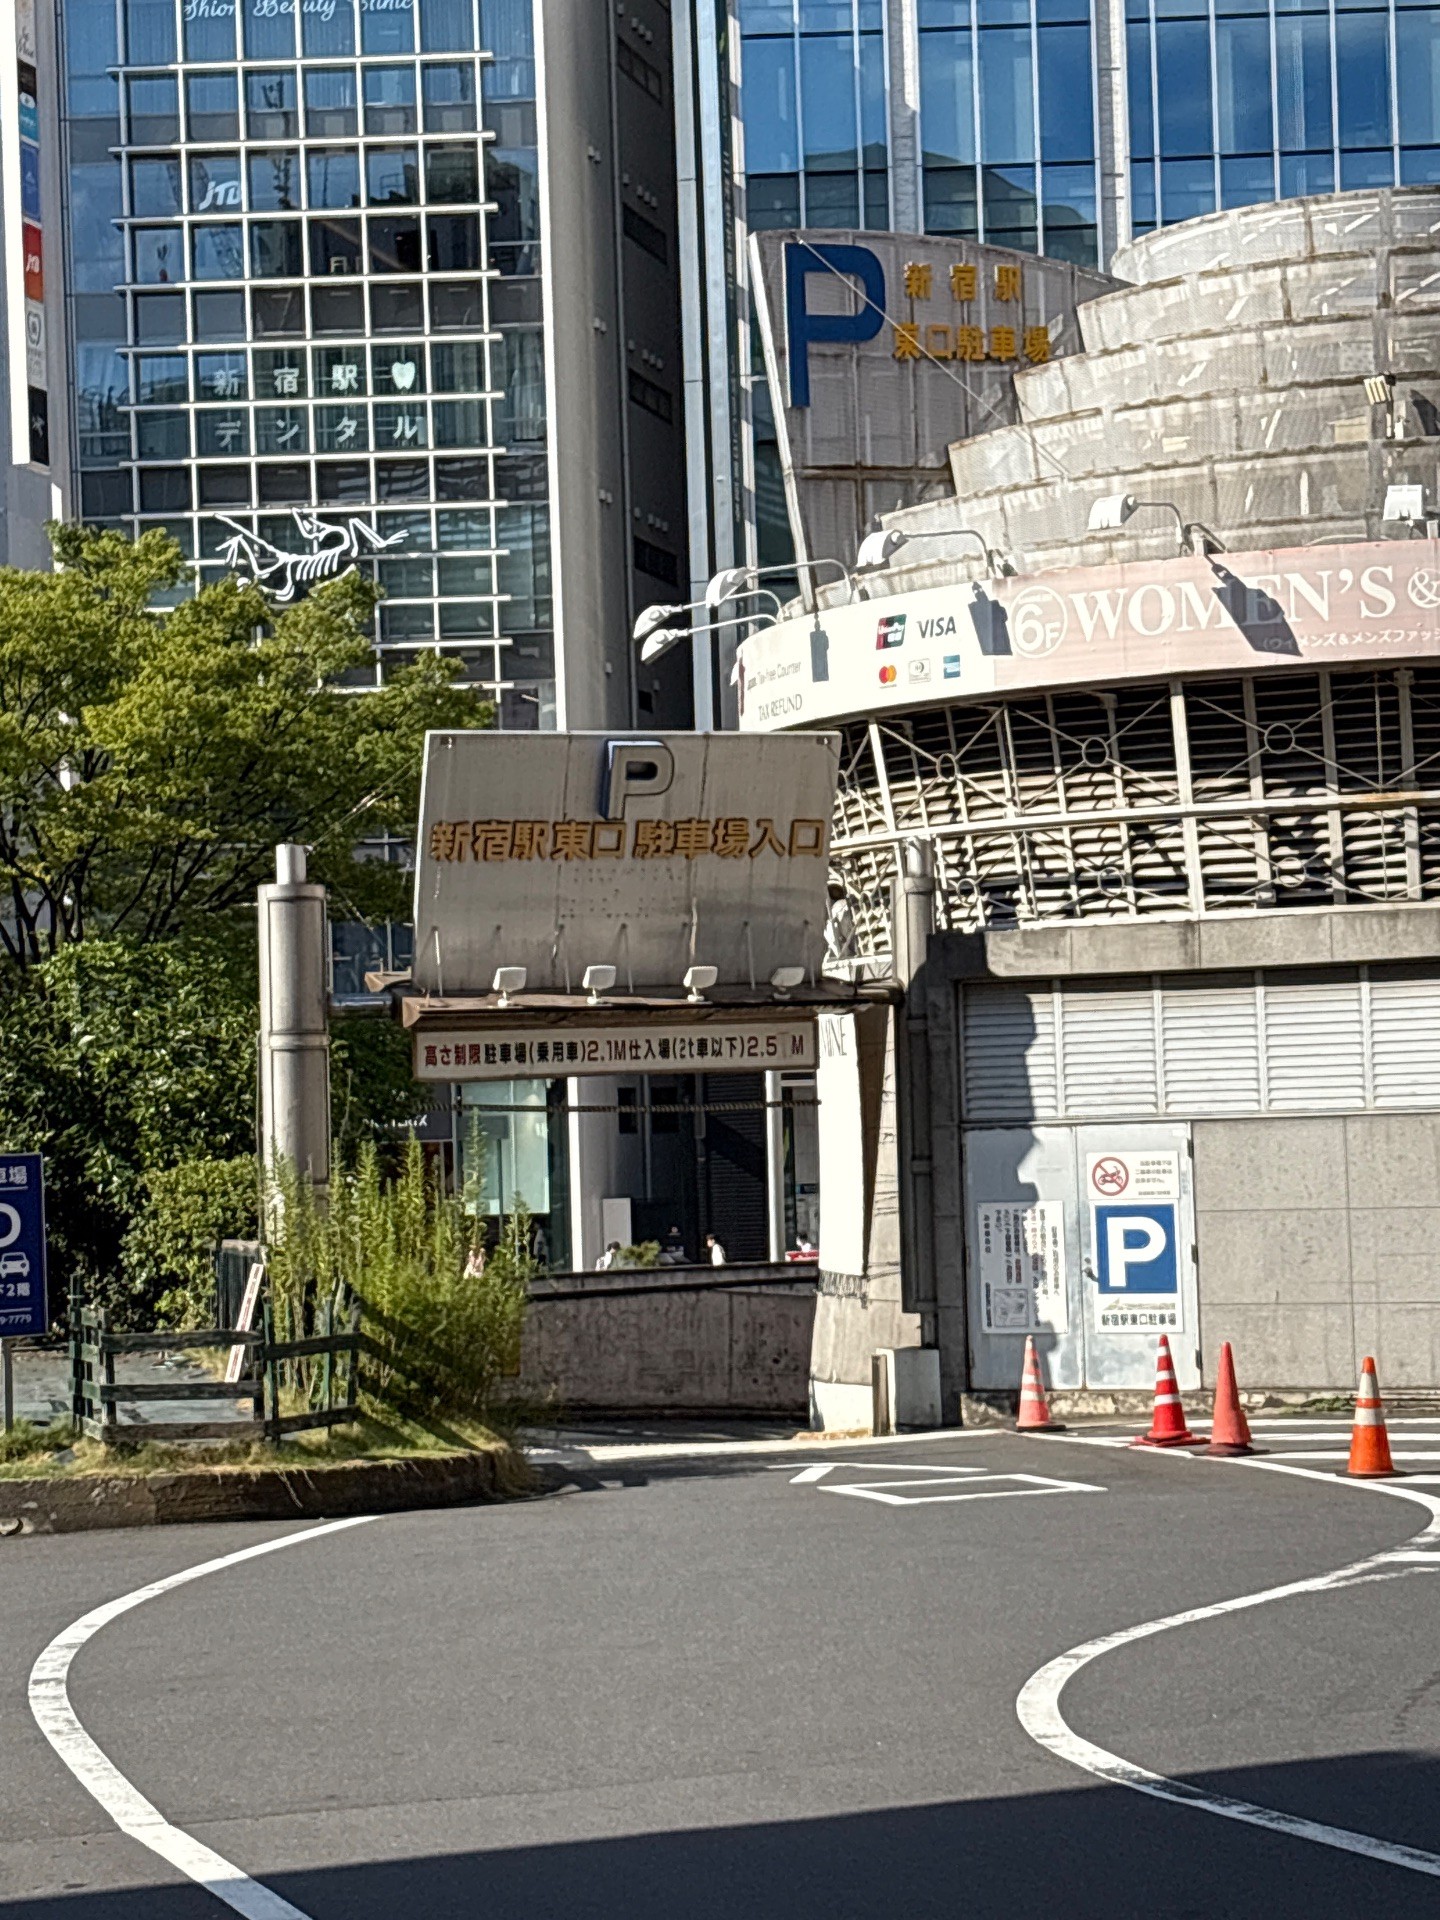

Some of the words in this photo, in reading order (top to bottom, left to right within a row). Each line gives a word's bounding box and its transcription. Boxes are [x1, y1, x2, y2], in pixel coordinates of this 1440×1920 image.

[904, 261, 1022, 301] 新宿駅
[781, 242, 886, 408] P
[893, 321, 1051, 362] 東口駐車場
[214, 364, 359, 396] 新宿駅
[215, 415, 419, 448] デンタル
[916, 616, 957, 639] VISA
[1014, 602, 1062, 652] 6F
[1408, 568, 1440, 609] &
[770, 693, 803, 717] REFUND
[602, 739, 675, 820] P
[430, 817, 826, 862] 新宿駅東口駐車場入口
[1106, 1216, 1167, 1287] P
